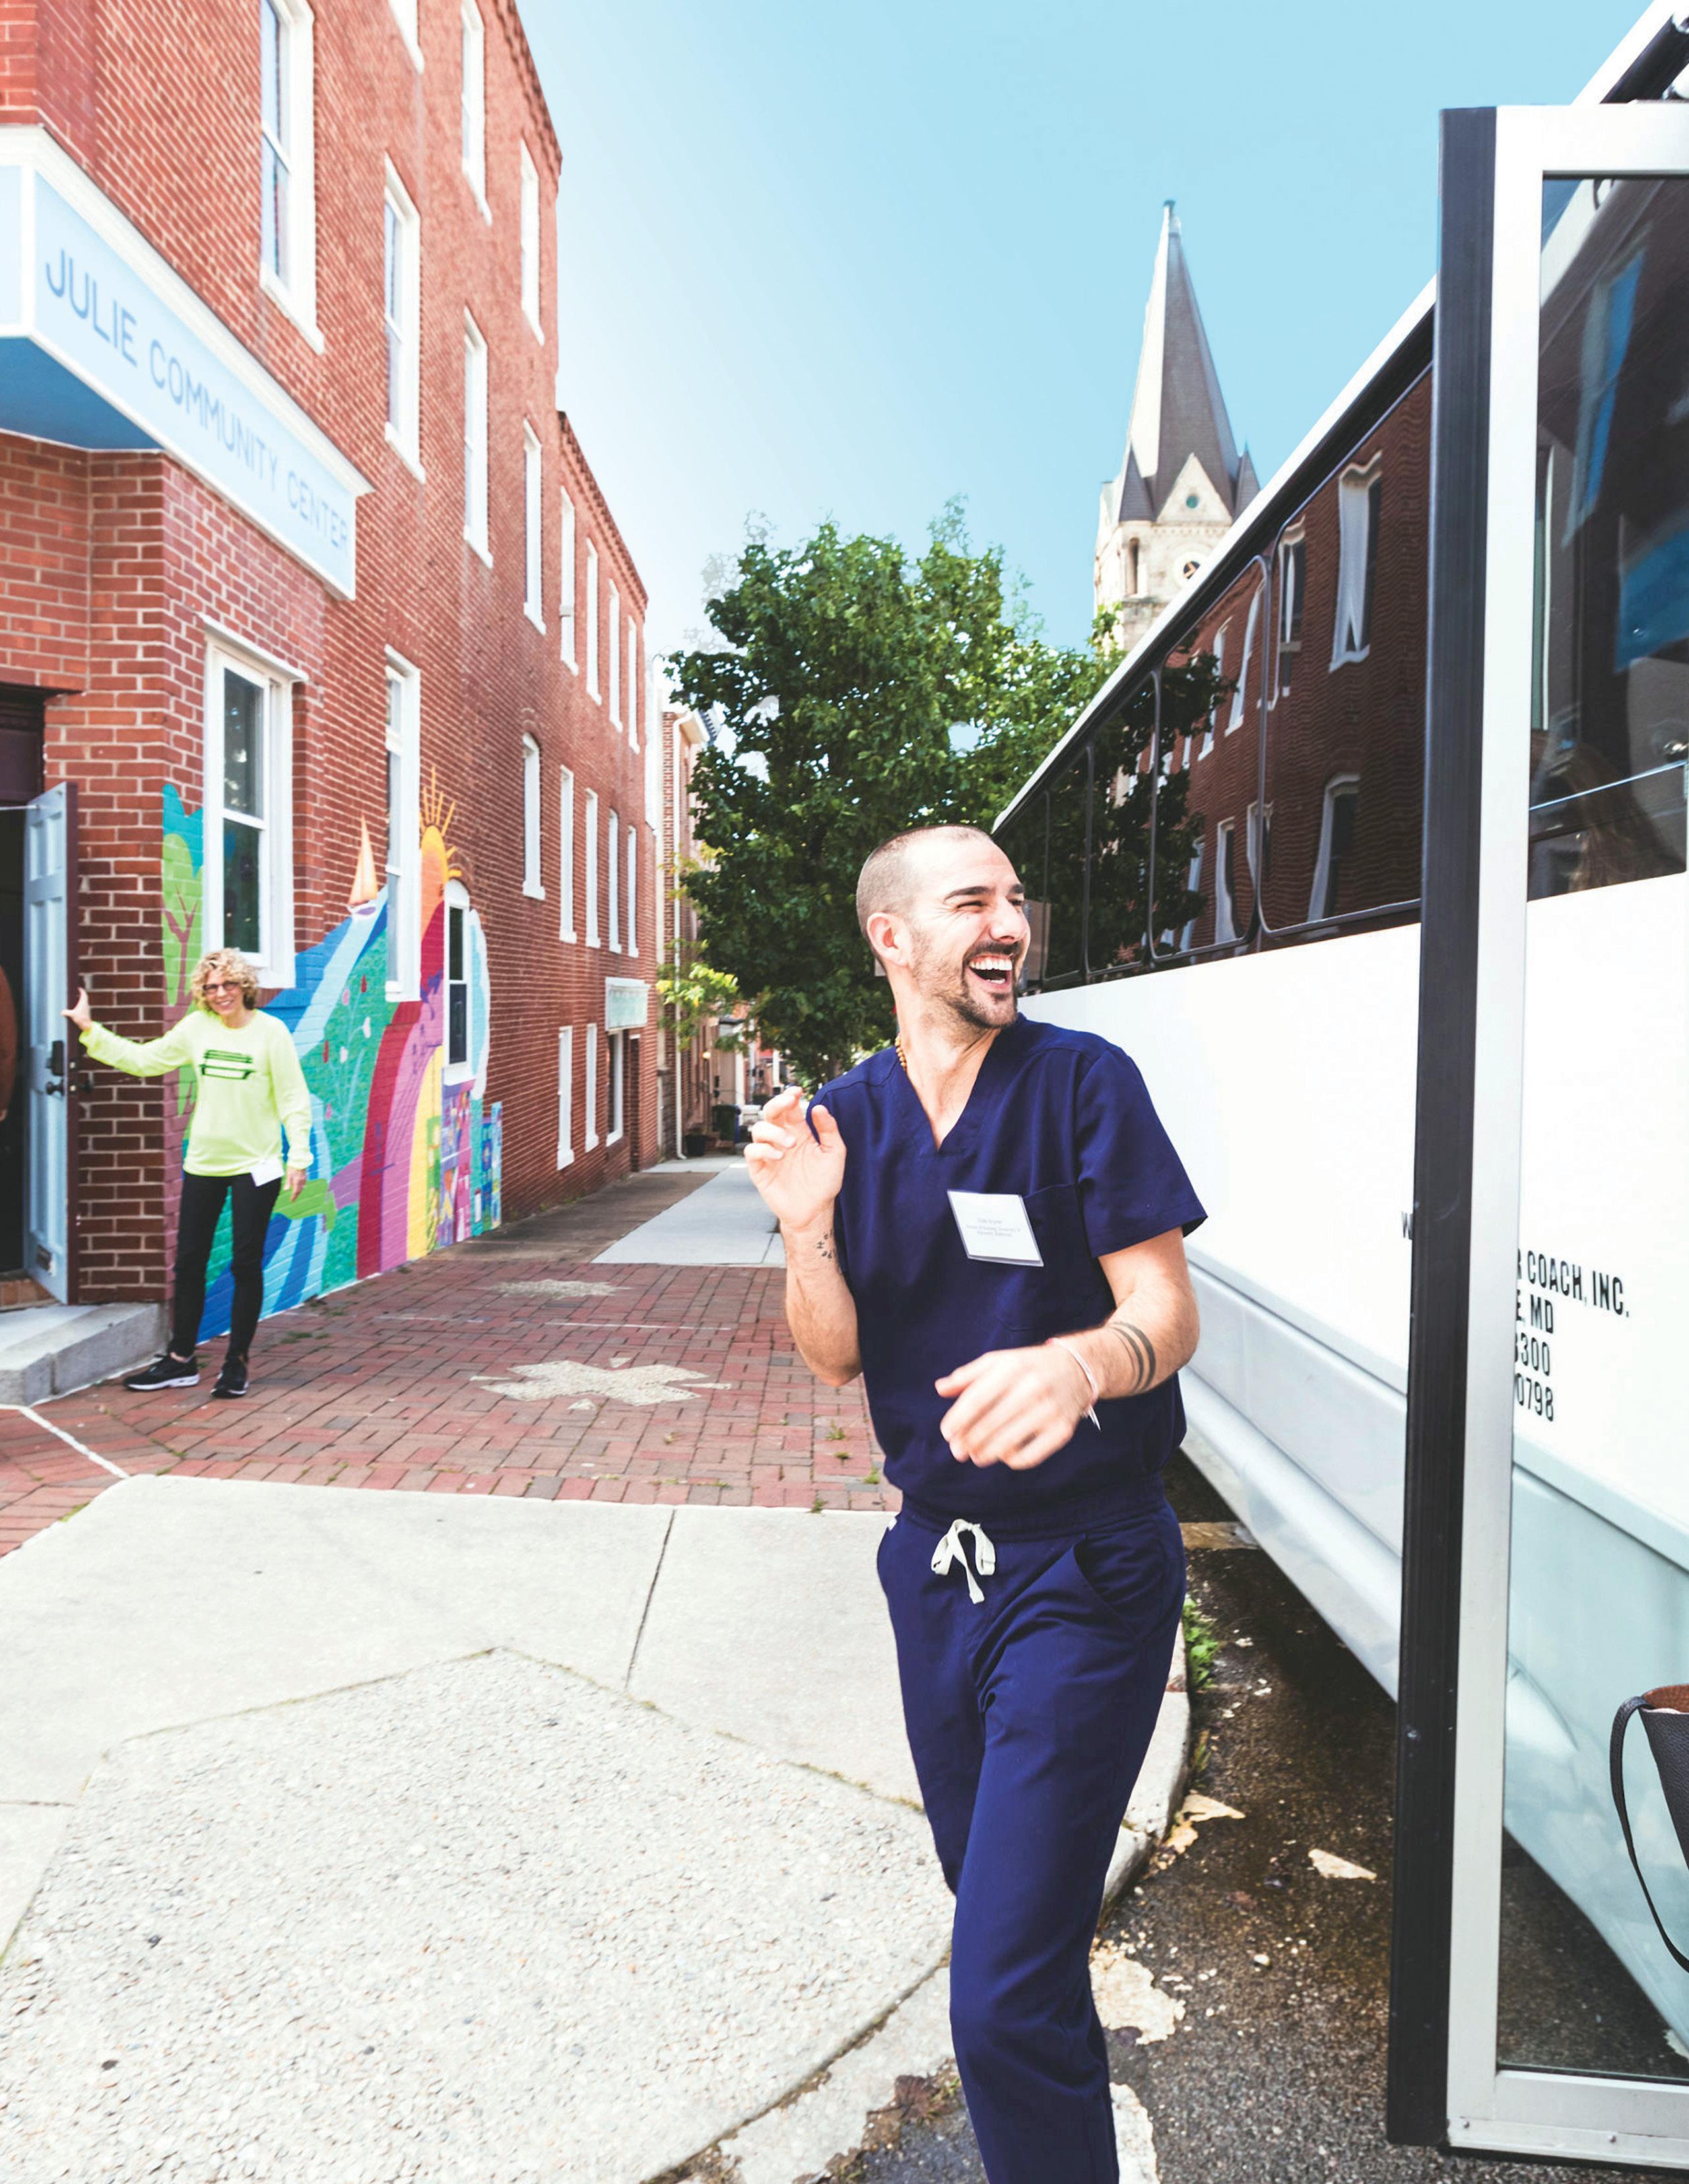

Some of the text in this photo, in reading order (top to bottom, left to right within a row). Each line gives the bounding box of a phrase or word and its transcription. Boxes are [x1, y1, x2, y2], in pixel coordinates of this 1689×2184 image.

[46, 249, 348, 558] JULIE COMMUNITY CENTER
[1530, 1294, 1554, 1334] MD
[1592, 1270, 1629, 1317] INC.
